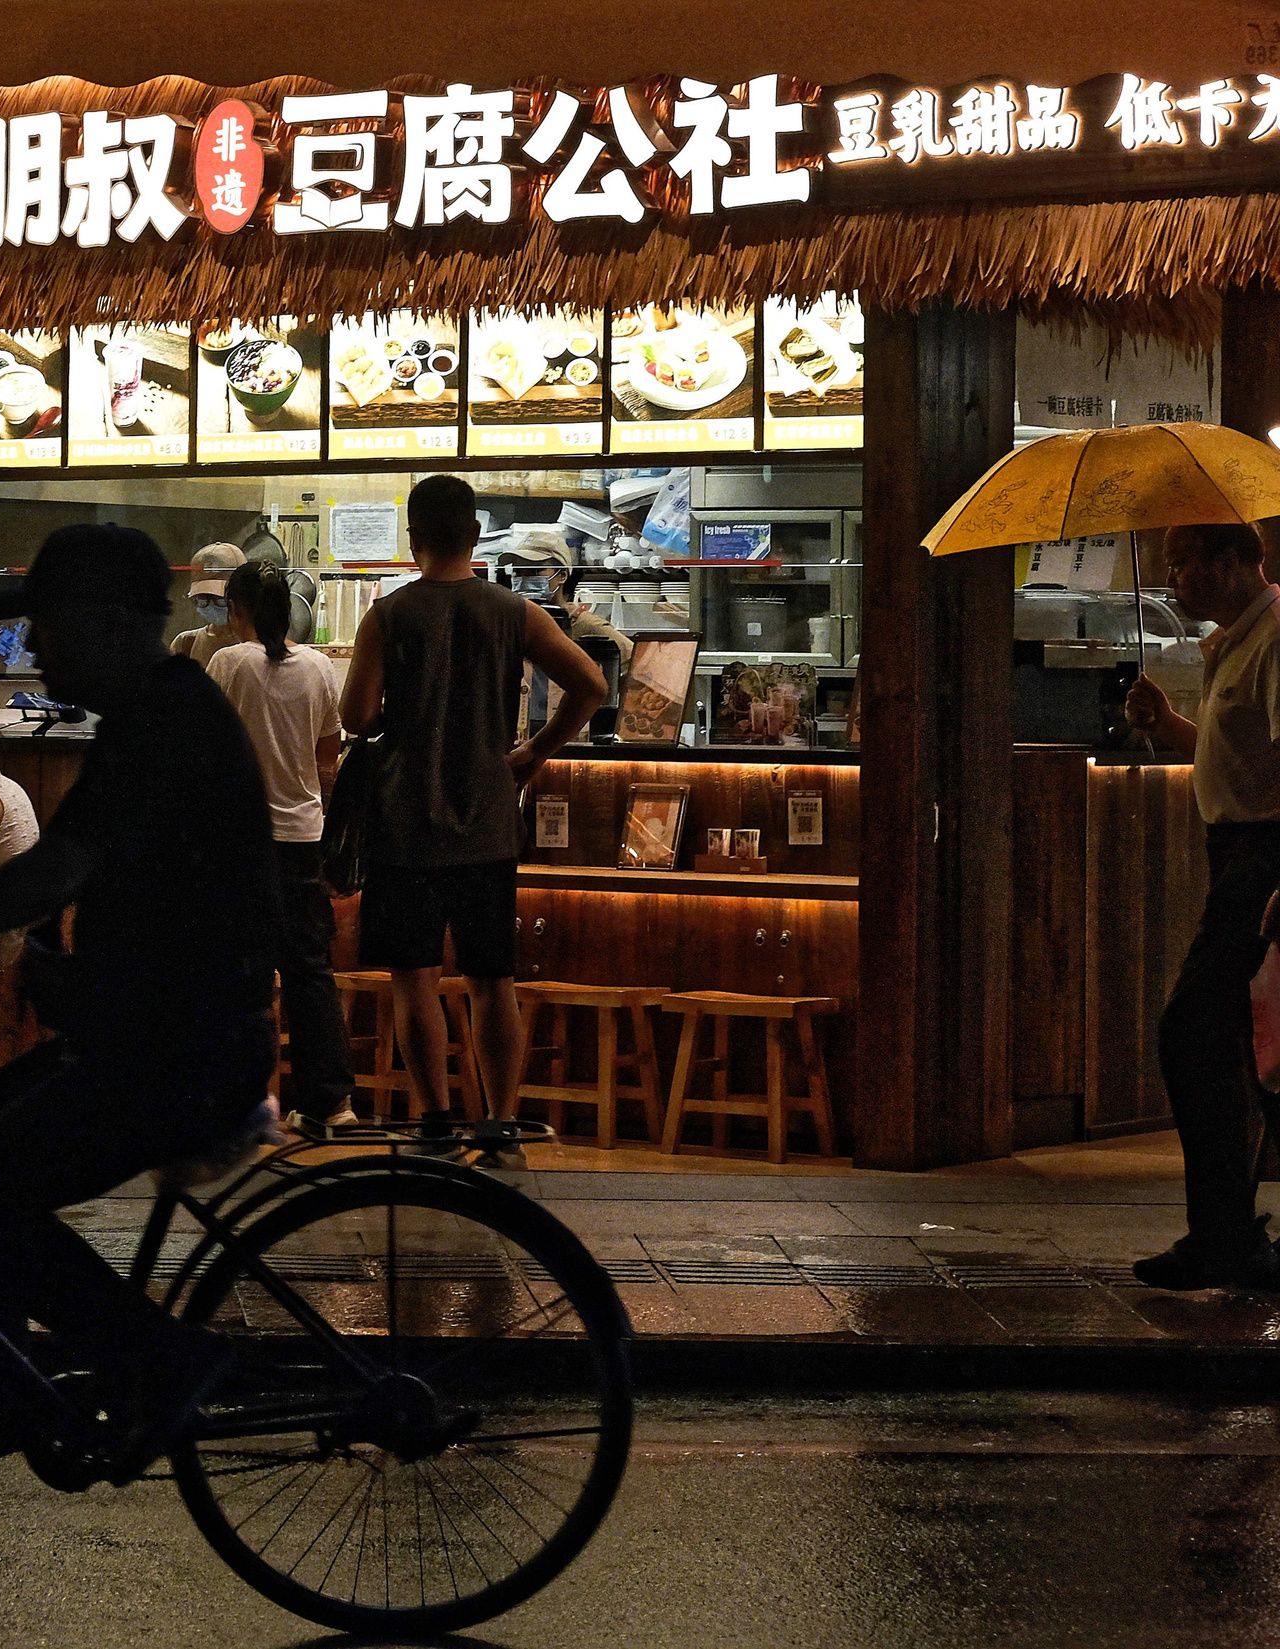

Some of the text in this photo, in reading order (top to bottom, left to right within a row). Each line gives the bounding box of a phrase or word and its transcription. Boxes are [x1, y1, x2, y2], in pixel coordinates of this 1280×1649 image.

[211, 116, 249, 217] 非遗
[272, 74, 811, 235] 豆腐公社
[827, 84, 1079, 165] 豆乳甜品
[704, 525, 731, 536] Icy fresh
